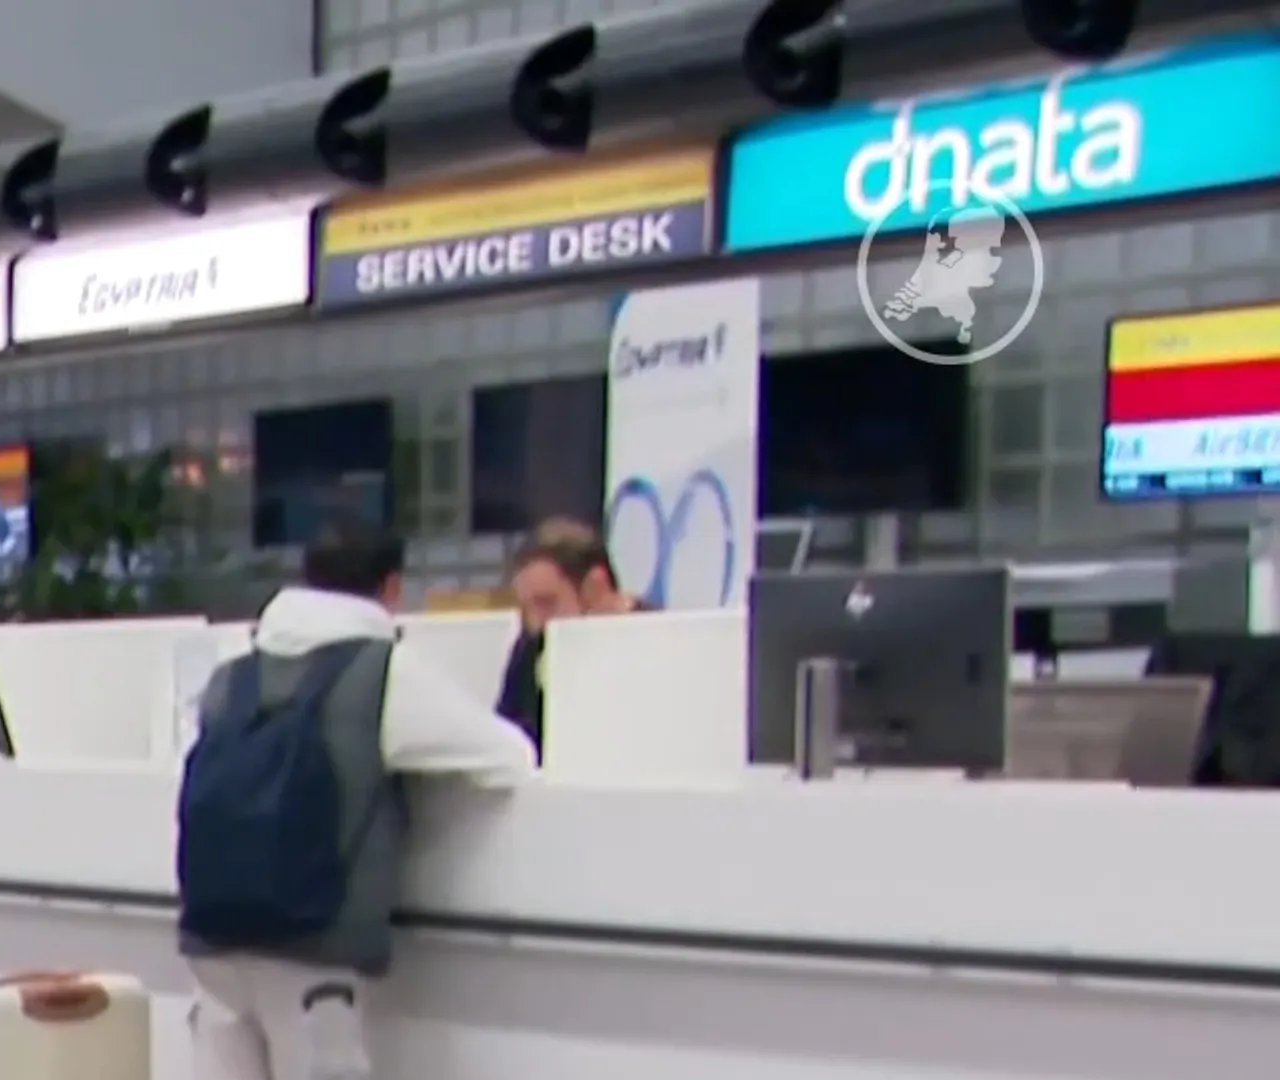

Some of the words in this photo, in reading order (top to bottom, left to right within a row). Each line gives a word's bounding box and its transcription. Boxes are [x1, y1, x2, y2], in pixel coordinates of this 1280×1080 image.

[844, 66, 1143, 220] dnata
[355, 232, 534, 294] SERVICE
[547, 211, 674, 268] DESK
